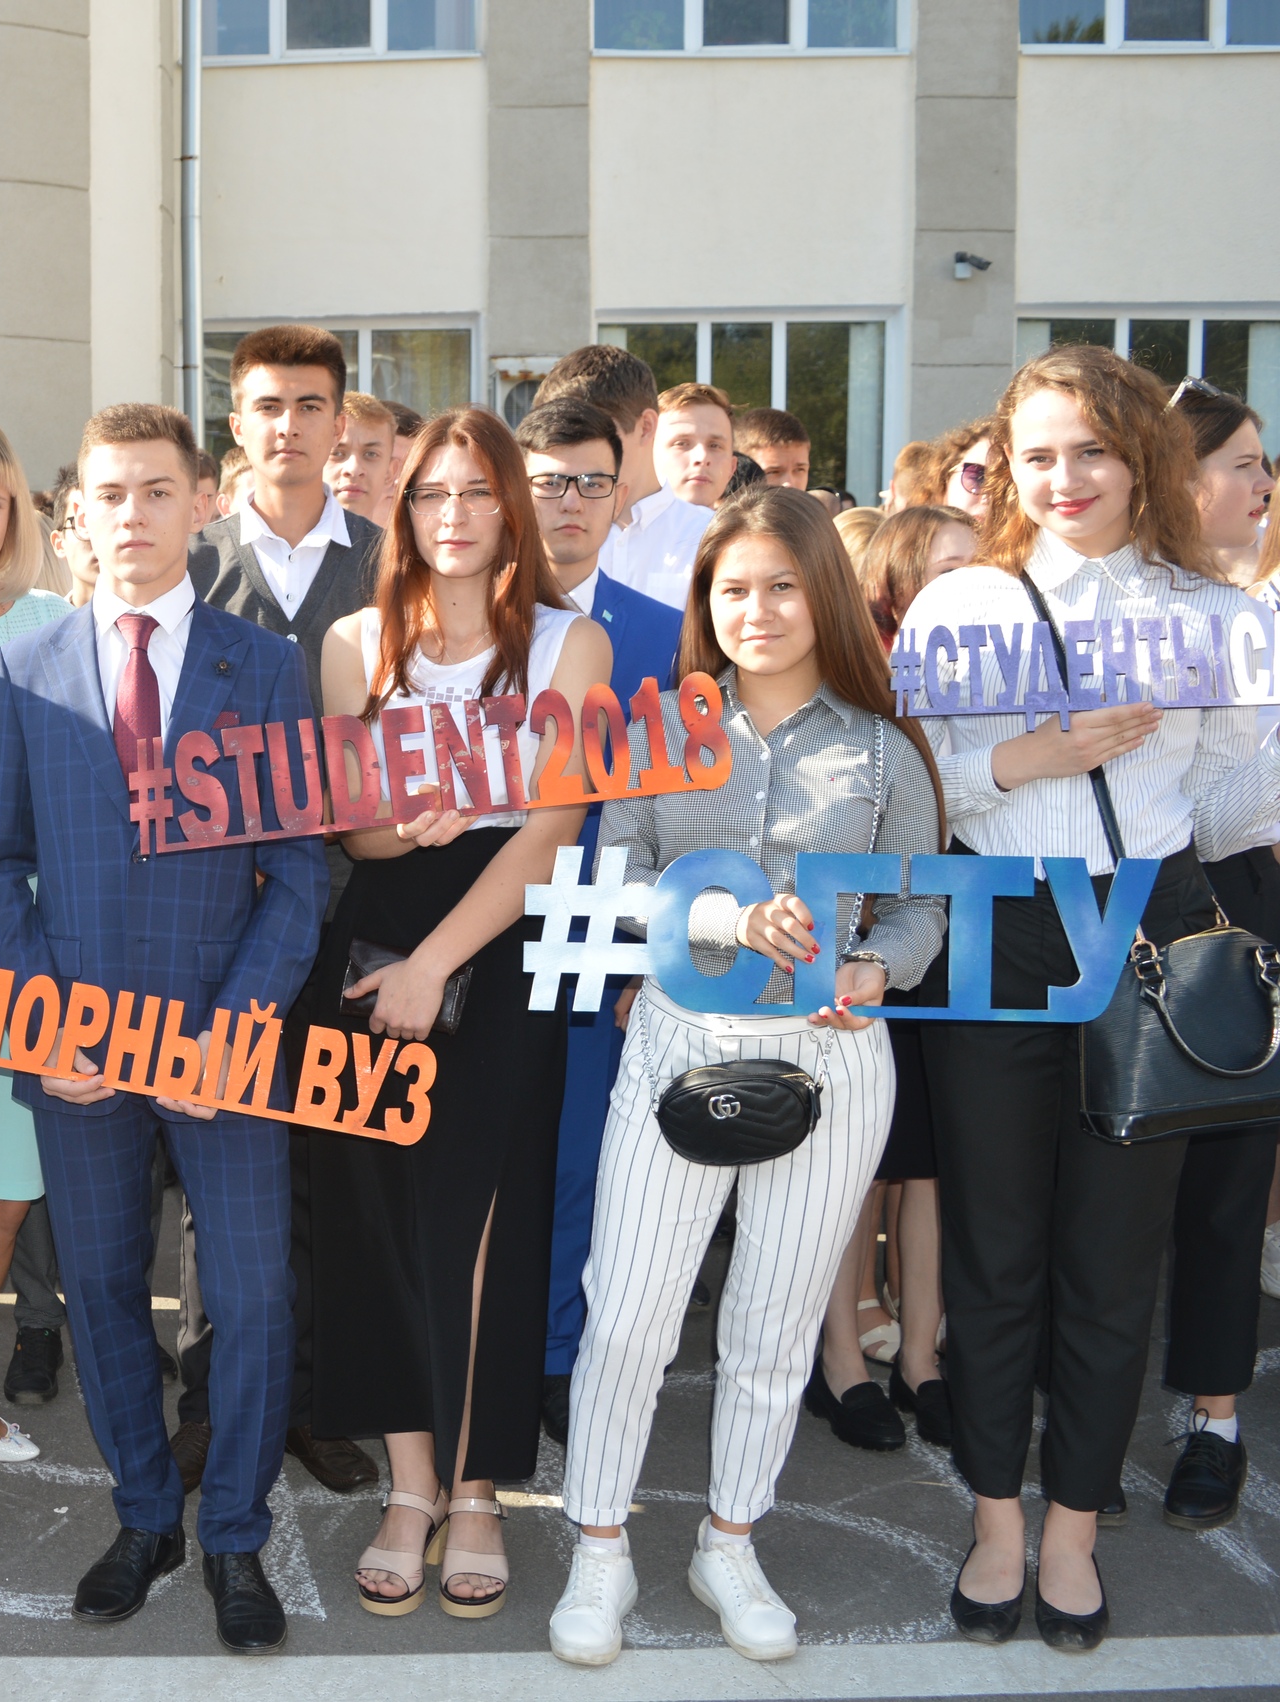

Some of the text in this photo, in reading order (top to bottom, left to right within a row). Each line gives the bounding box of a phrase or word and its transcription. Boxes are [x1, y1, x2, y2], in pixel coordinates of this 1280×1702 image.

[890, 611, 1280, 732] #СТУДЕНТЫС
[128, 671, 732, 855] #STUDENT2018
[523, 845, 1162, 1022] #СГТУ
[295, 1025, 438, 1146] ВУЗ
